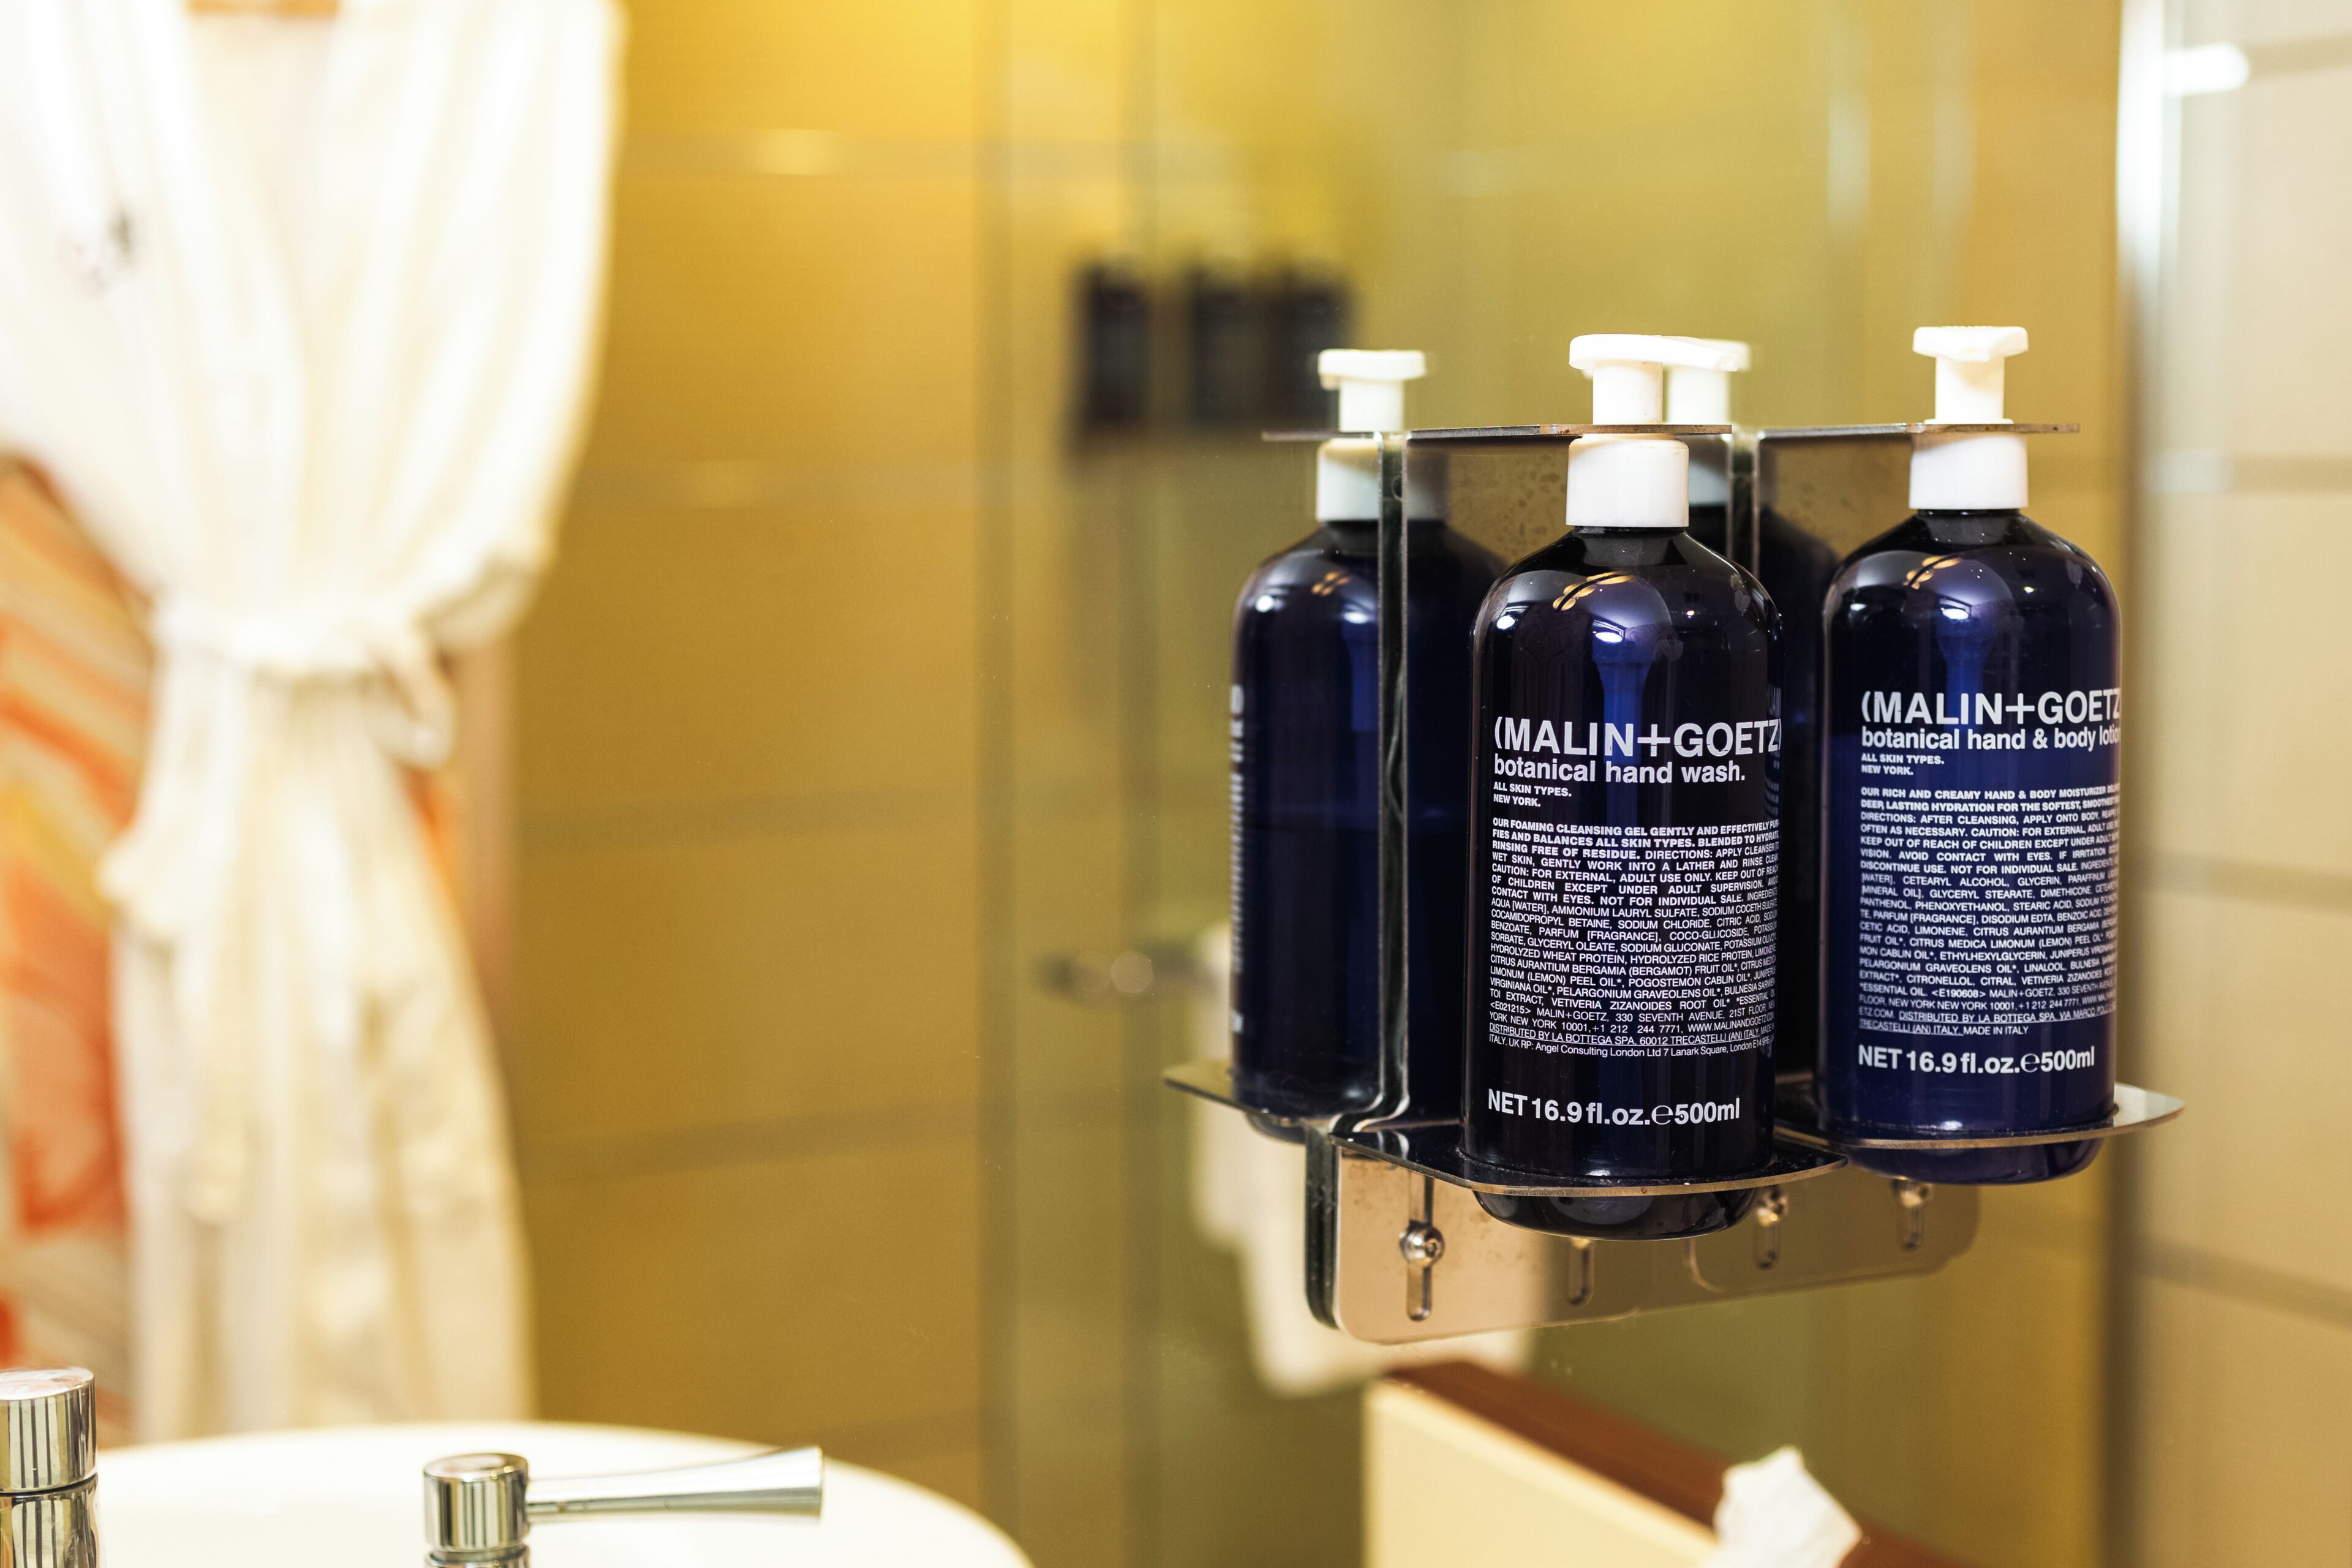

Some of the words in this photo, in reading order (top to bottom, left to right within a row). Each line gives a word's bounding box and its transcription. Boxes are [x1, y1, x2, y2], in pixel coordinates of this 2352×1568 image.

[1862, 726, 1959, 749] botanical
[1967, 729, 2026, 750] hand
[2033, 729, 2048, 748] &
[2055, 726, 2096, 752] body
[1494, 753, 1596, 782] botanical
[1605, 761, 1672, 783] hand
[1681, 760, 1746, 782] wash.
[1861, 753, 1878, 762] ALL
[1880, 754, 1904, 763] SKIN
[1906, 755, 1945, 764] TYPES.
[1861, 764, 1881, 774] NEW
[1883, 766, 1913, 775] YORK.
[1493, 782, 1507, 791] ALL
[1509, 783, 1531, 794] SKIN
[1534, 785, 1572, 797] TYPES.
[1861, 786, 1880, 797] OUR
[1882, 788, 1906, 798] RICH
[1909, 789, 1932, 799] AND
[1934, 790, 1981, 800] CREAMY
[1984, 790, 2015, 800] HAND
[2018, 790, 2027, 799] &
[2029, 789, 2057, 799] BODY
[2059, 785, 2106, 798] MOISTURIZER
[1493, 793, 1510, 804] NEW
[1512, 796, 1541, 807] YORK.
[1886, 801, 1929, 812] LASTING
[1931, 802, 1995, 813] HYDRATION
[1997, 802, 2019, 812] FOR
[2020, 802, 2041, 812] THE
[2041, 800, 2082, 812] SOFTEST,
[1493, 817, 1509, 828] OUR
[1510, 820, 1554, 832] FOAMING
[1556, 823, 1622, 836] CLEANSING
[1624, 826, 1648, 836] GEL
[1649, 826, 1695, 836] GENTLY
[1696, 826, 1719, 835] AND
[1720, 821, 1770, 835] EFFECTIVELY
[1861, 811, 1916, 823] DIRECTIONS:
[1920, 815, 1953, 824] AFTER
[1957, 815, 2019, 826] CLEANSING,
[2023, 814, 2053, 824] APPLY
[2056, 813, 2079, 823] ONTO
[1493, 828, 1510, 840] FIES
[1511, 831, 1531, 842] AND
[1533, 833, 1593, 846] BALANCES
[1595, 837, 1619, 847] ALL
[1621, 838, 1651, 848] SKIN
[1654, 838, 1695, 848] TYPES.
[1698, 835, 1743, 847] BLENDED
[1744, 834, 1755, 844] TO
[1860, 823, 1888, 834] OFTEN
[1890, 826, 1902, 835] AS
[1905, 826, 1968, 837] NECESSARY.
[1970, 827, 2019, 837] CAUTION:
[2022, 827, 2042, 837] FOR
[1492, 840, 1528, 853] RINSING
[1531, 845, 1559, 856] FREE
[1562, 847, 1578, 857] OF
[1583, 848, 1640, 859] RESIDUE.
[1645, 849, 1713, 859] DIRECTIONS:
[1716, 847, 1743, 858] APPLY
[1744, 842, 1775, 856] CLEANSER
[1860, 835, 1883, 846] KEEP
[1884, 837, 1904, 847] OUT
[1906, 839, 1921, 848] OF
[1923, 839, 1959, 849] REACH
[1962, 840, 1977, 850] OF
[1980, 840, 2032, 850] CHILDREN
[2034, 838, 2070, 849] EXCEPT
[2070, 835, 2095, 847] UNDER
[1492, 851, 1508, 862] WET
[1512, 854, 1535, 867] SKIN,
[1540, 857, 1581, 869] GENTLY
[1587, 860, 1623, 871] WORK
[1629, 862, 1656, 871] INTO
[1662, 862, 1670, 871] A
[1676, 861, 1715, 871] LATHER
[1719, 859, 1738, 869] AND
[1743, 856, 1763, 867] RINSE
[1860, 848, 1891, 859] VISION.
[1898, 851, 1929, 861] AVOID
[1936, 852, 1986, 862] CONTACT
[1994, 852, 2019, 862] WITH
[2027, 851, 2052, 861] EYES.
[2059, 850, 2067, 860] IF
[1492, 862, 1529, 876] CAUTION:
[1532, 868, 1552, 879] FOR
[1555, 870, 1616, 884] EXTERNAL,
[1619, 873, 1656, 883] ADULT
[1659, 873, 1681, 883] USE
[1684, 872, 1713, 883] ONLY.
[1716, 870, 1738, 881] KEEP
[1740, 869, 1755, 879] OUT
[1757, 867, 1765, 877] OF
[1860, 860, 1920, 873] DISCONTINUE
[1923, 864, 1947, 874] USE.
[1950, 865, 1973, 874] NOT
[1976, 865, 1997, 875] FOR
[2001, 864, 2054, 874] INDIVIDUAL
[2057, 862, 2079, 873] SALE.
[1491, 874, 1502, 884] OF
[1508, 876, 1555, 891] CHILDREN
[1564, 882, 1608, 894] EXCEPT
[1618, 885, 1657, 894] UNDER
[1668, 884, 1702, 894] ADULT
[1711, 879, 1764, 893] SUPERVISION.
[1491, 886, 1529, 899] CONTACT
[1532, 891, 1558, 902] WITH
[1563, 894, 1594, 905] EYES.
[1600, 895, 1624, 906] NOT
[1629, 897, 1653, 907] FOR
[1658, 895, 1717, 906] INDIVIDUAL
[1721, 894, 1744, 904] SALE.
[1491, 897, 1510, 908] AQUA
[1512, 900, 1550, 915] [WATER],
[1551, 905, 1610, 917] AMMONIUM
[1612, 908, 1653, 918] LAURYL
[1654, 908, 1700, 918] SULFATE,
[1702, 905, 1735, 916] SODIUM
[1963, 1026, 1991, 1035] MADE
[1993, 1026, 2003, 1035] IN
[2005, 1026, 2029, 1035] ITALY
[1489, 1033, 1507, 1046] ITALY.
[1509, 1038, 1520, 1048] UK
[1521, 1039, 1534, 1050] RP:
[1535, 1042, 1559, 1054] Angel
[1561, 1044, 1608, 1058] Consulting
[1610, 1047, 1645, 1057] London
[1647, 1048, 1661, 1057] Ltd
[1664, 1048, 1669, 1057] 7
[1671, 1047, 1699, 1057] Lanark
[1700, 1046, 1728, 1056] Square,
[1730, 1042, 1752, 1052] London
[1858, 1044, 1902, 1069] NET
[1906, 1050, 1957, 1072] 16.9
[1488, 1088, 1528, 1116] NET
[1532, 1098, 1583, 1123] 16.9
